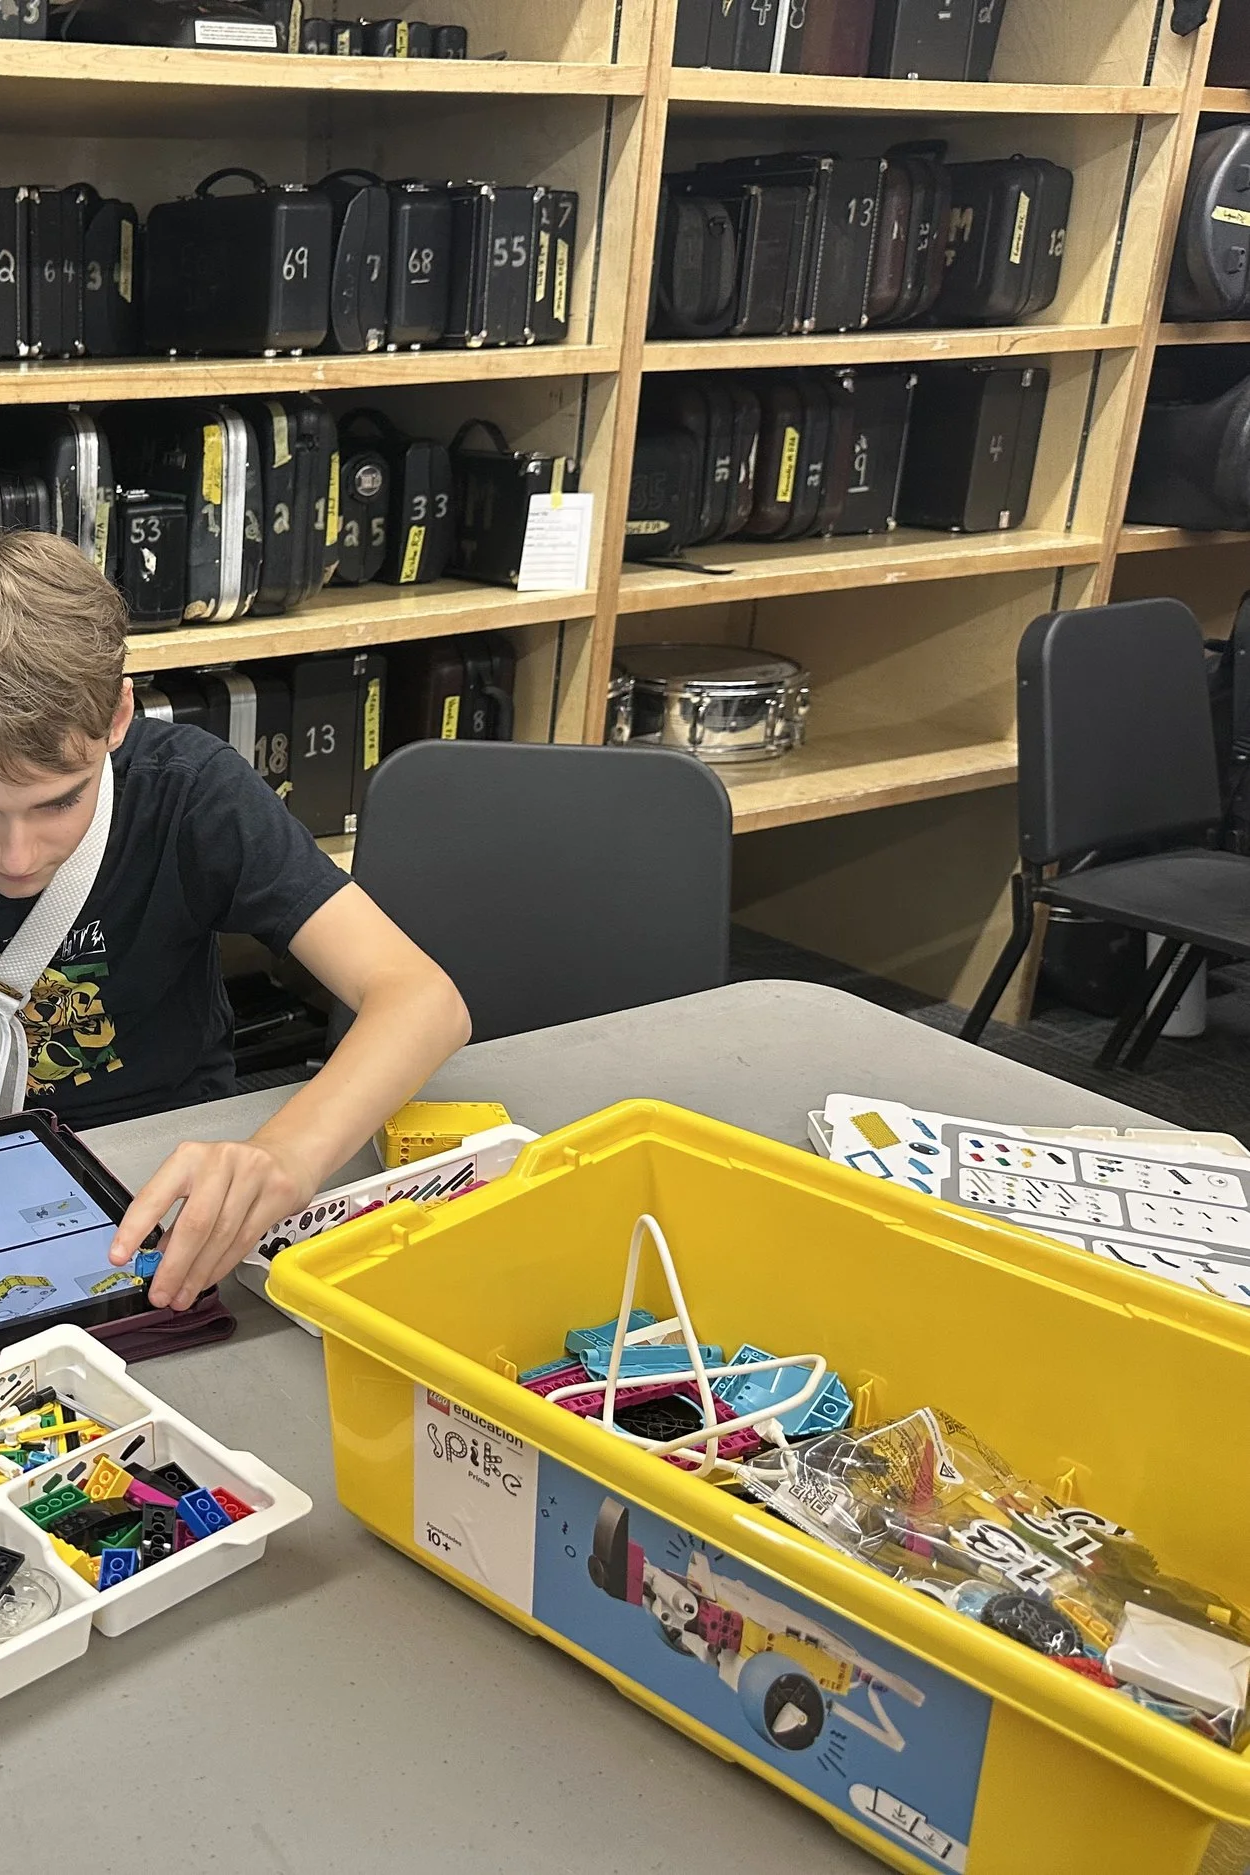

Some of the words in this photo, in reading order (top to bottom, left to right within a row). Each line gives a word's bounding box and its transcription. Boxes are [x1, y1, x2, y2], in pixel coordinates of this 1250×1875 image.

[847, 198, 875, 227] 13
[282, 247, 309, 281] 69
[407, 247, 434, 275] 68
[492, 235, 527, 268] 55
[130, 518, 162, 544] 53
[473, 710, 486, 733] 8
[254, 732, 289, 777] 18
[304, 724, 336, 758] 13
[453, 1403, 524, 1450] education
[467, 1469, 491, 1489] Prime
[426, 1528, 452, 1552] 10+
